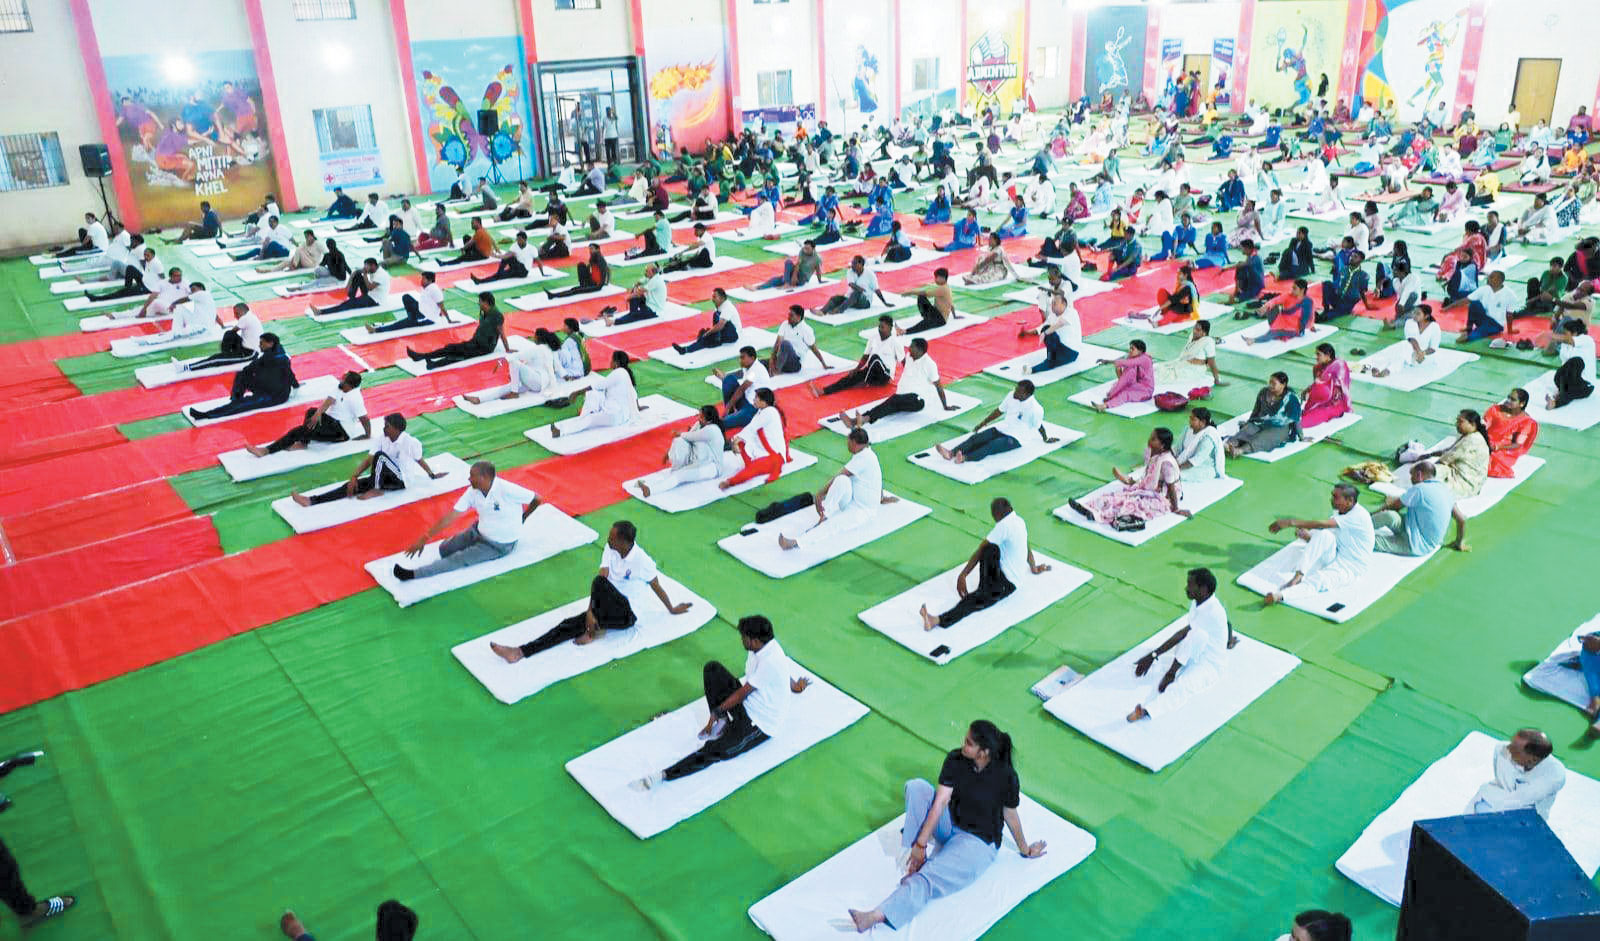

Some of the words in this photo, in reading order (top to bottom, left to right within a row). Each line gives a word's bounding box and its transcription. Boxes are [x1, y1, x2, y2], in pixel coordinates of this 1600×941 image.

[189, 145, 213, 159] APNI
[196, 169, 224, 181] APNA
[195, 180, 229, 196] KHEL
